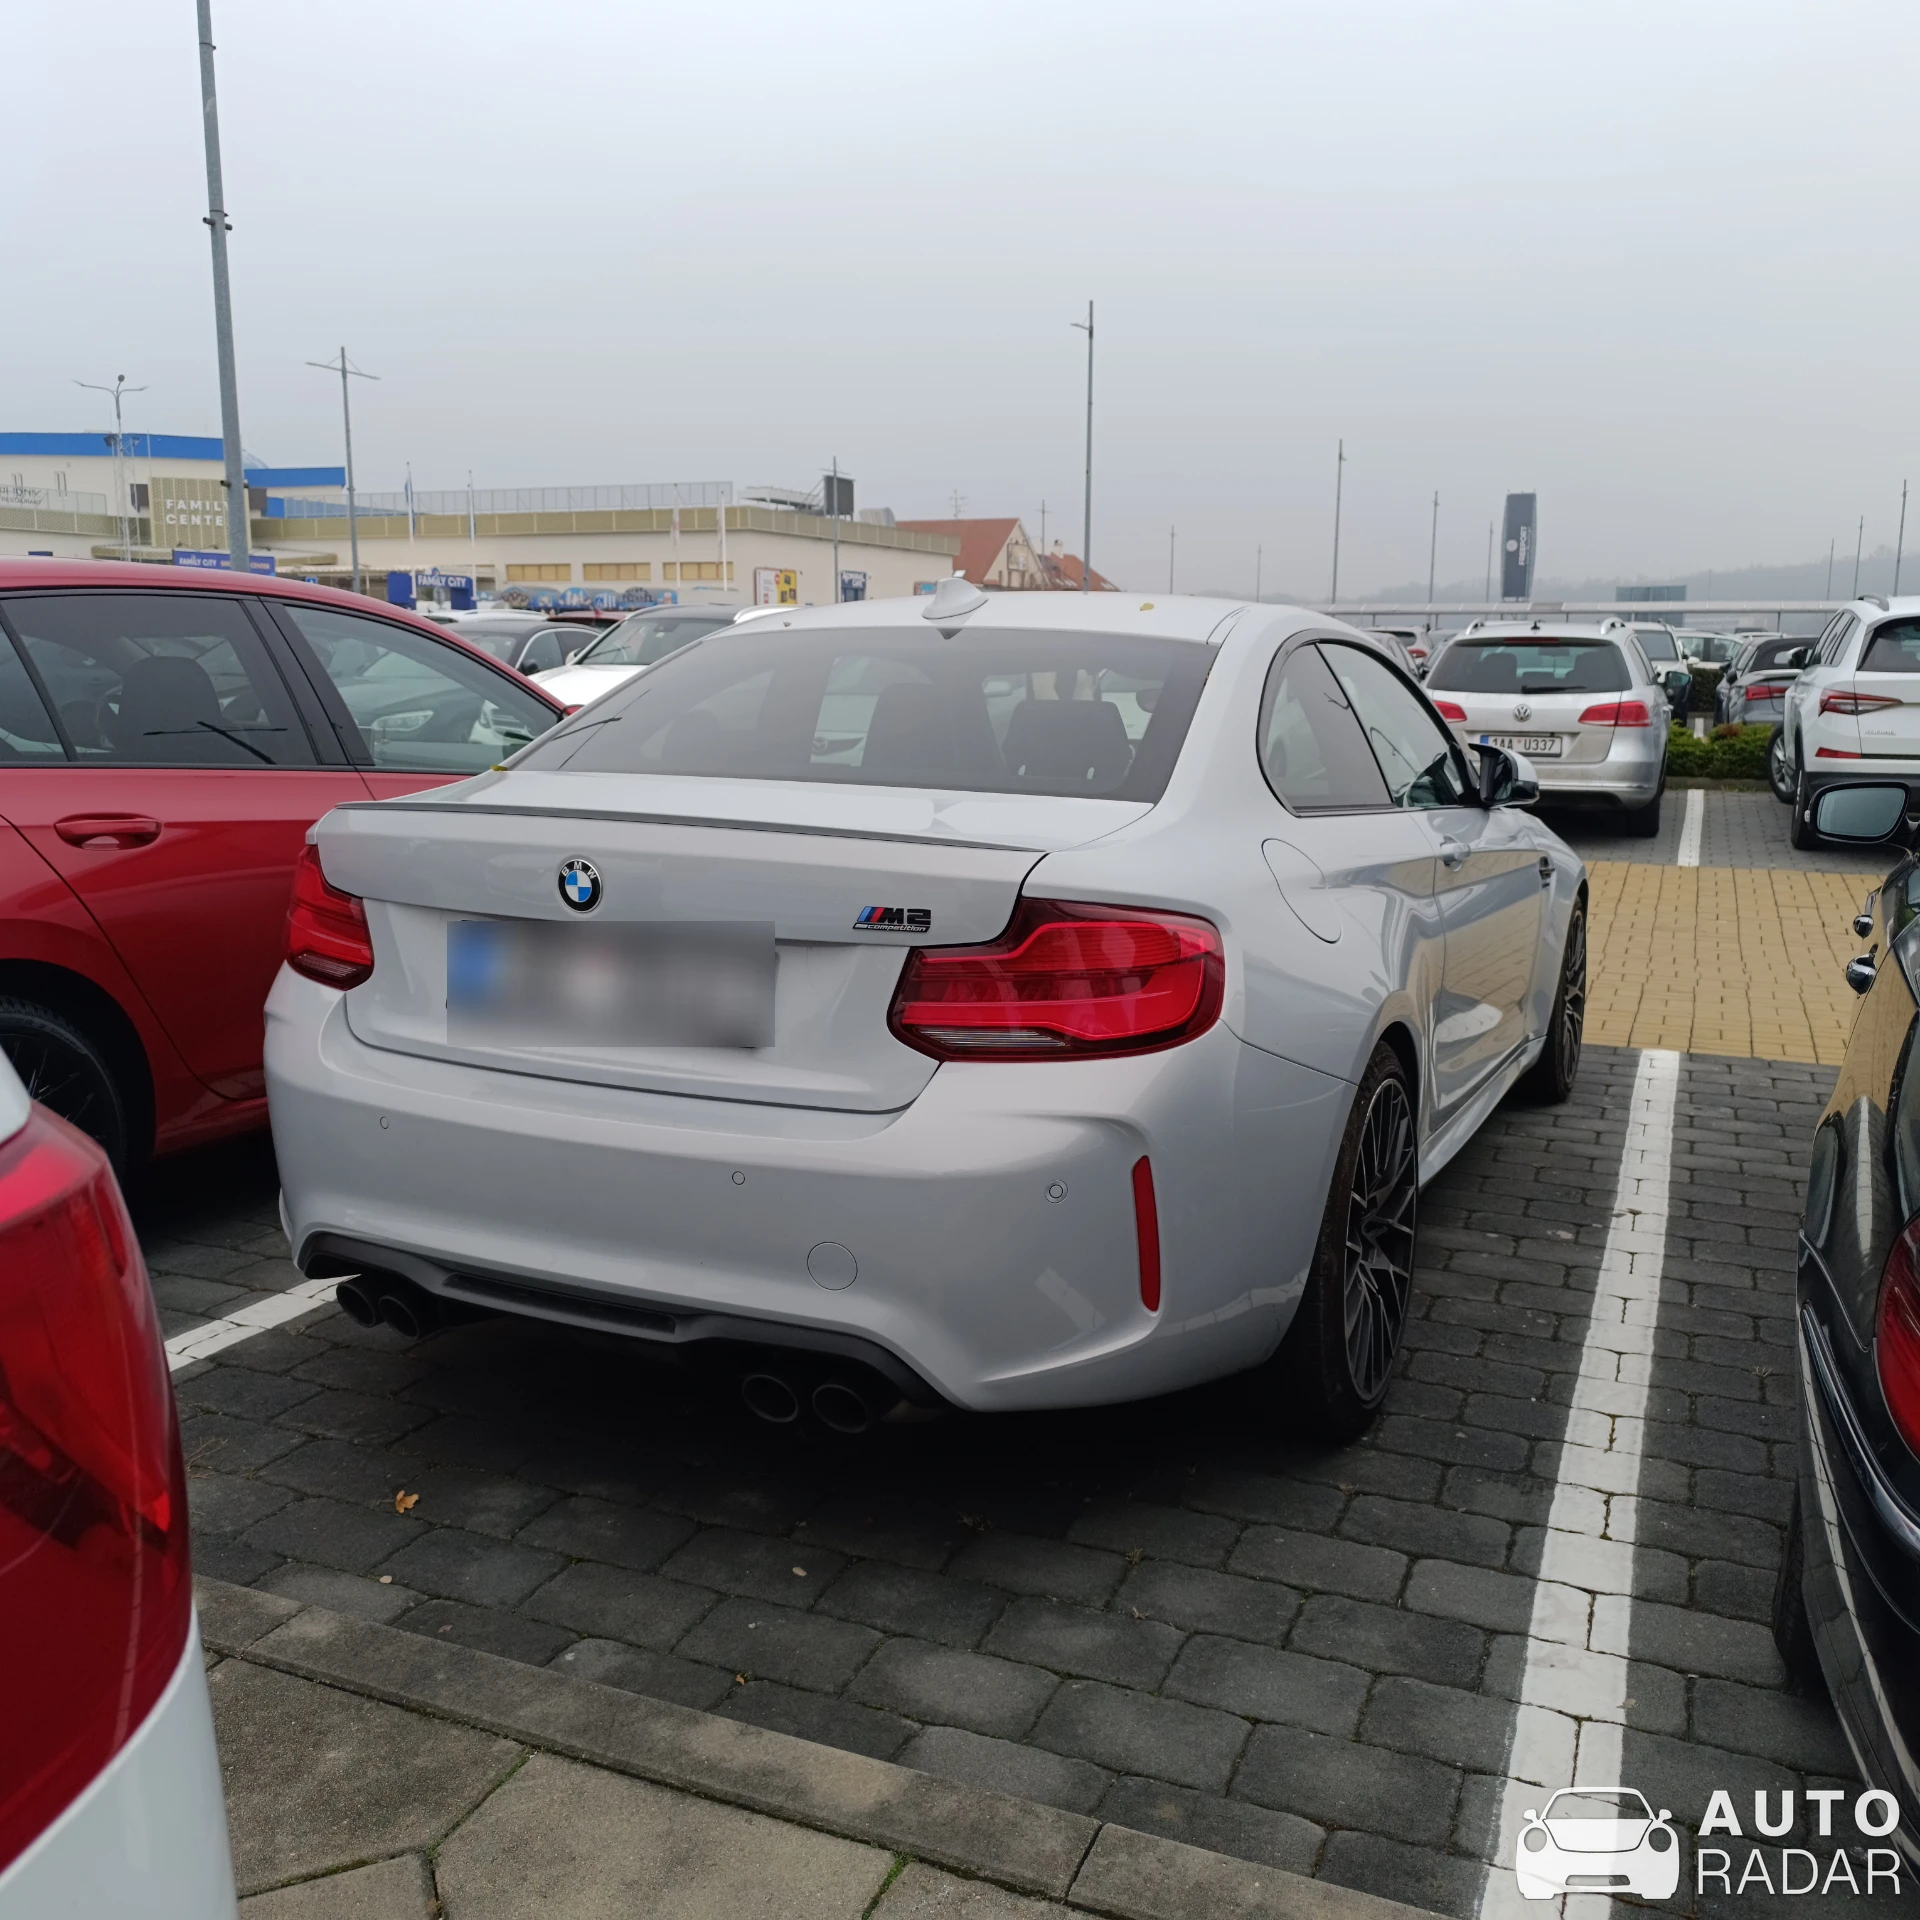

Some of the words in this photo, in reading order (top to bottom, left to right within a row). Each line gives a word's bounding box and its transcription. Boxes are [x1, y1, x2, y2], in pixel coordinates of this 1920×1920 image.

[166, 514, 223, 526] CENTE
[417, 574, 446, 587] FAMILY
[1523, 739, 1556, 752] U337
[561, 860, 597, 880] BMW
[879, 907, 932, 926] M2
[867, 924, 926, 932] competition
